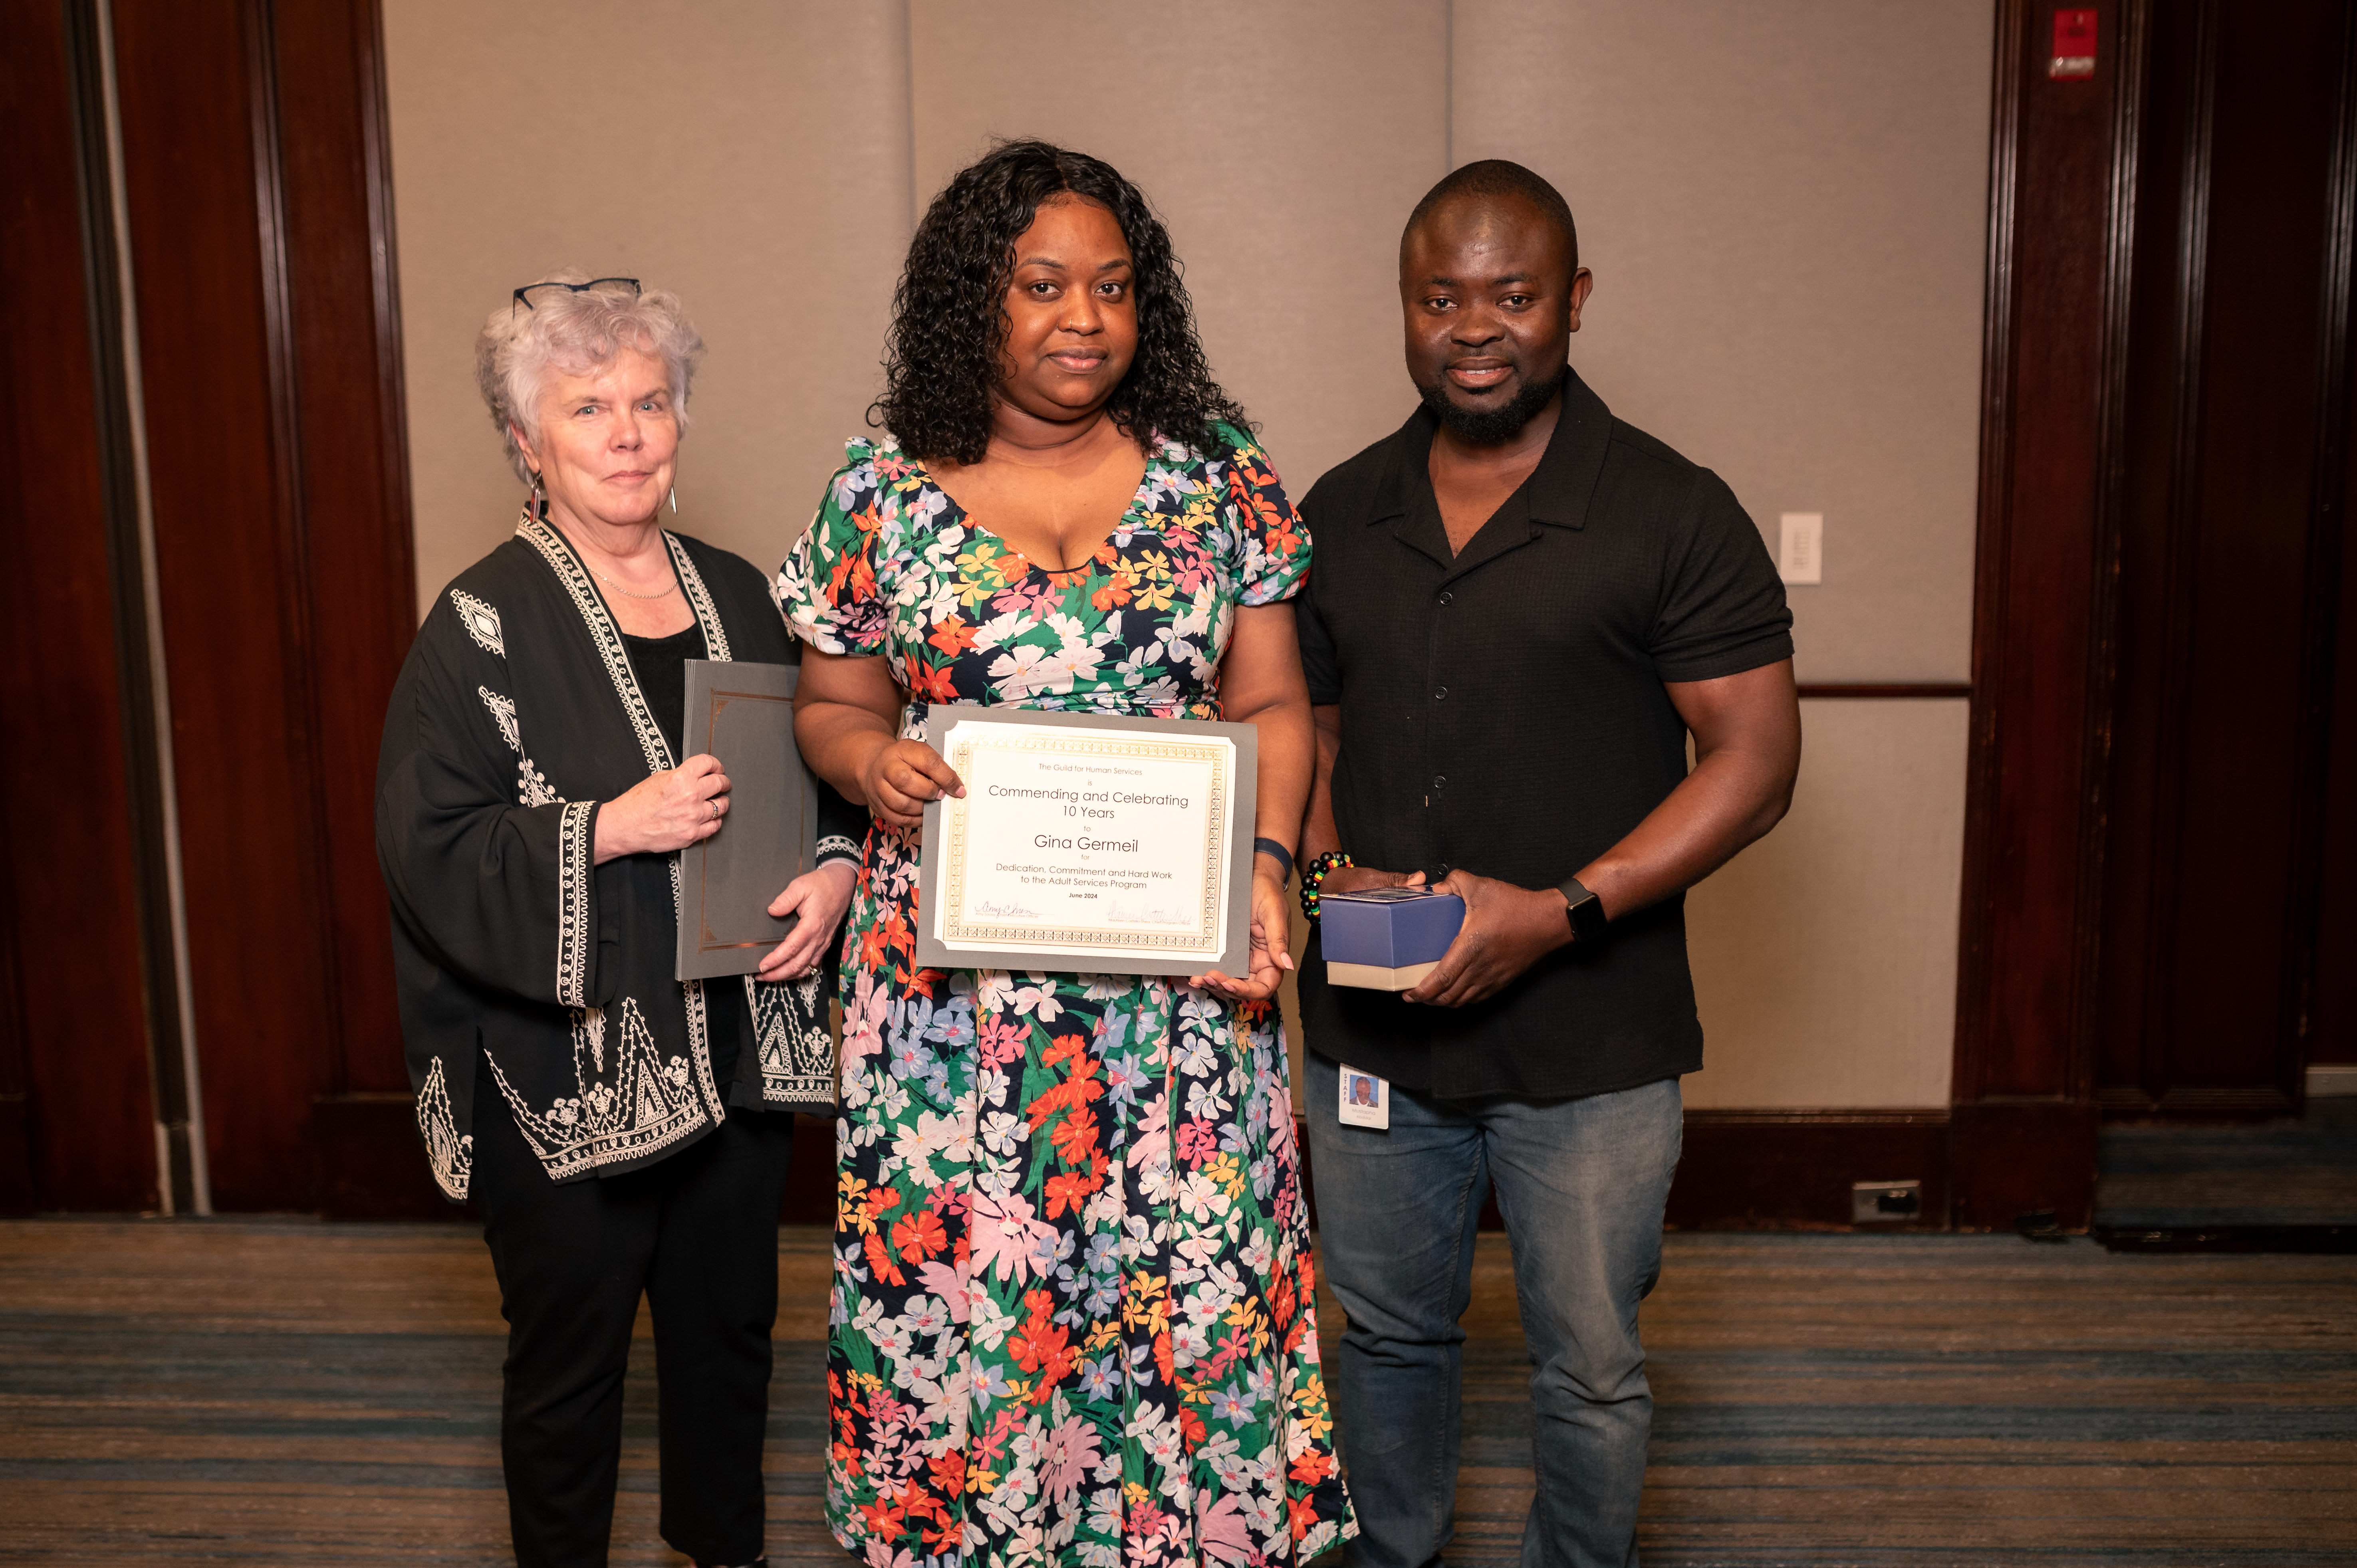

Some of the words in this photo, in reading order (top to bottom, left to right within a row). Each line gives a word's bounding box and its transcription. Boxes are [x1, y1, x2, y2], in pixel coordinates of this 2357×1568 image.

[989, 785, 1078, 803] Commending
[1083, 791, 1108, 802] and
[1113, 792, 1188, 809] Celebrating
[1064, 806, 1076, 817] 10
[1081, 807, 1114, 819] Years
[1034, 835, 1071, 849] Gina
[1077, 837, 1138, 852] Germeil
[996, 863, 1046, 873] Dedication,
[1049, 866, 1105, 876] Commitment
[1151, 871, 1172, 879] Work
[1073, 878, 1108, 887] Services
[1111, 880, 1147, 890] Program
